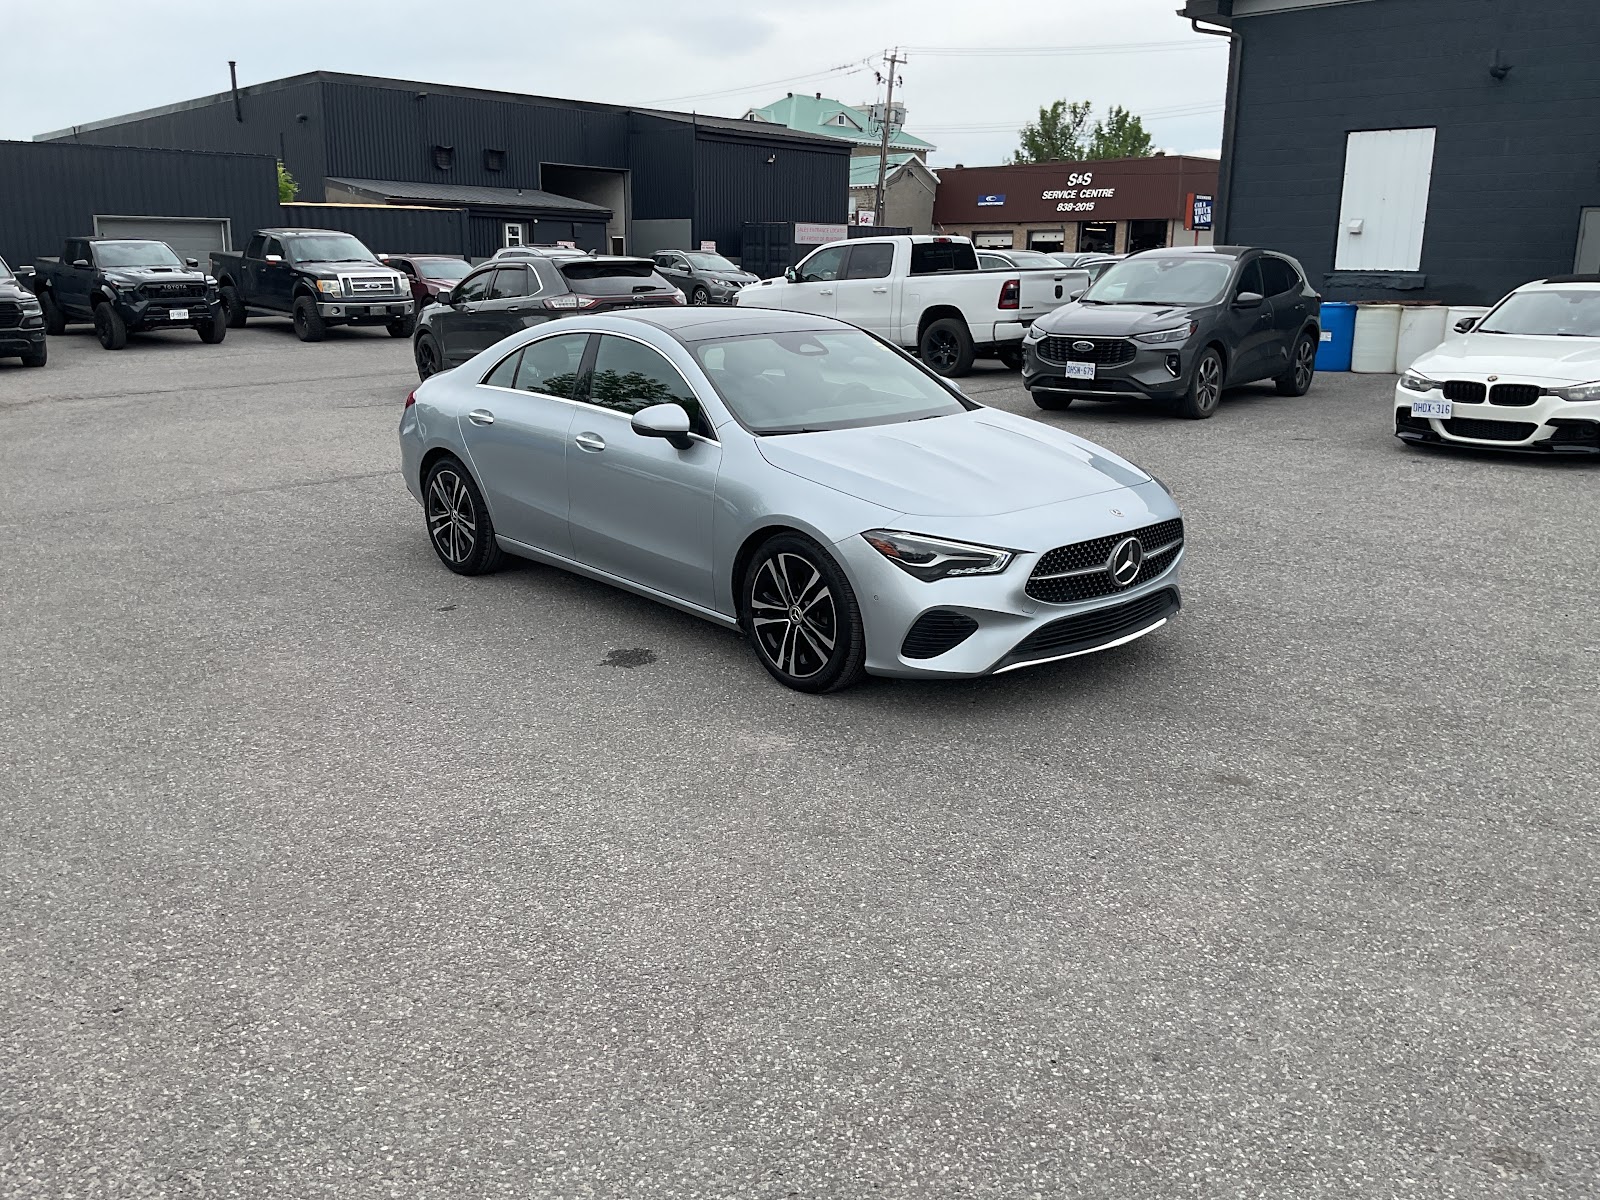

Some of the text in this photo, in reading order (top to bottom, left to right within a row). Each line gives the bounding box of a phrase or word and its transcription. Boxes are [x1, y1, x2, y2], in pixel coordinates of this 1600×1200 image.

[1067, 172, 1092, 186] S&S
[1041, 188, 1115, 199] SERVICE CENTRE
[1056, 202, 1095, 212] 838-2015
[1194, 206, 1211, 215] TRUCK
[1194, 213, 1211, 224] WASH
